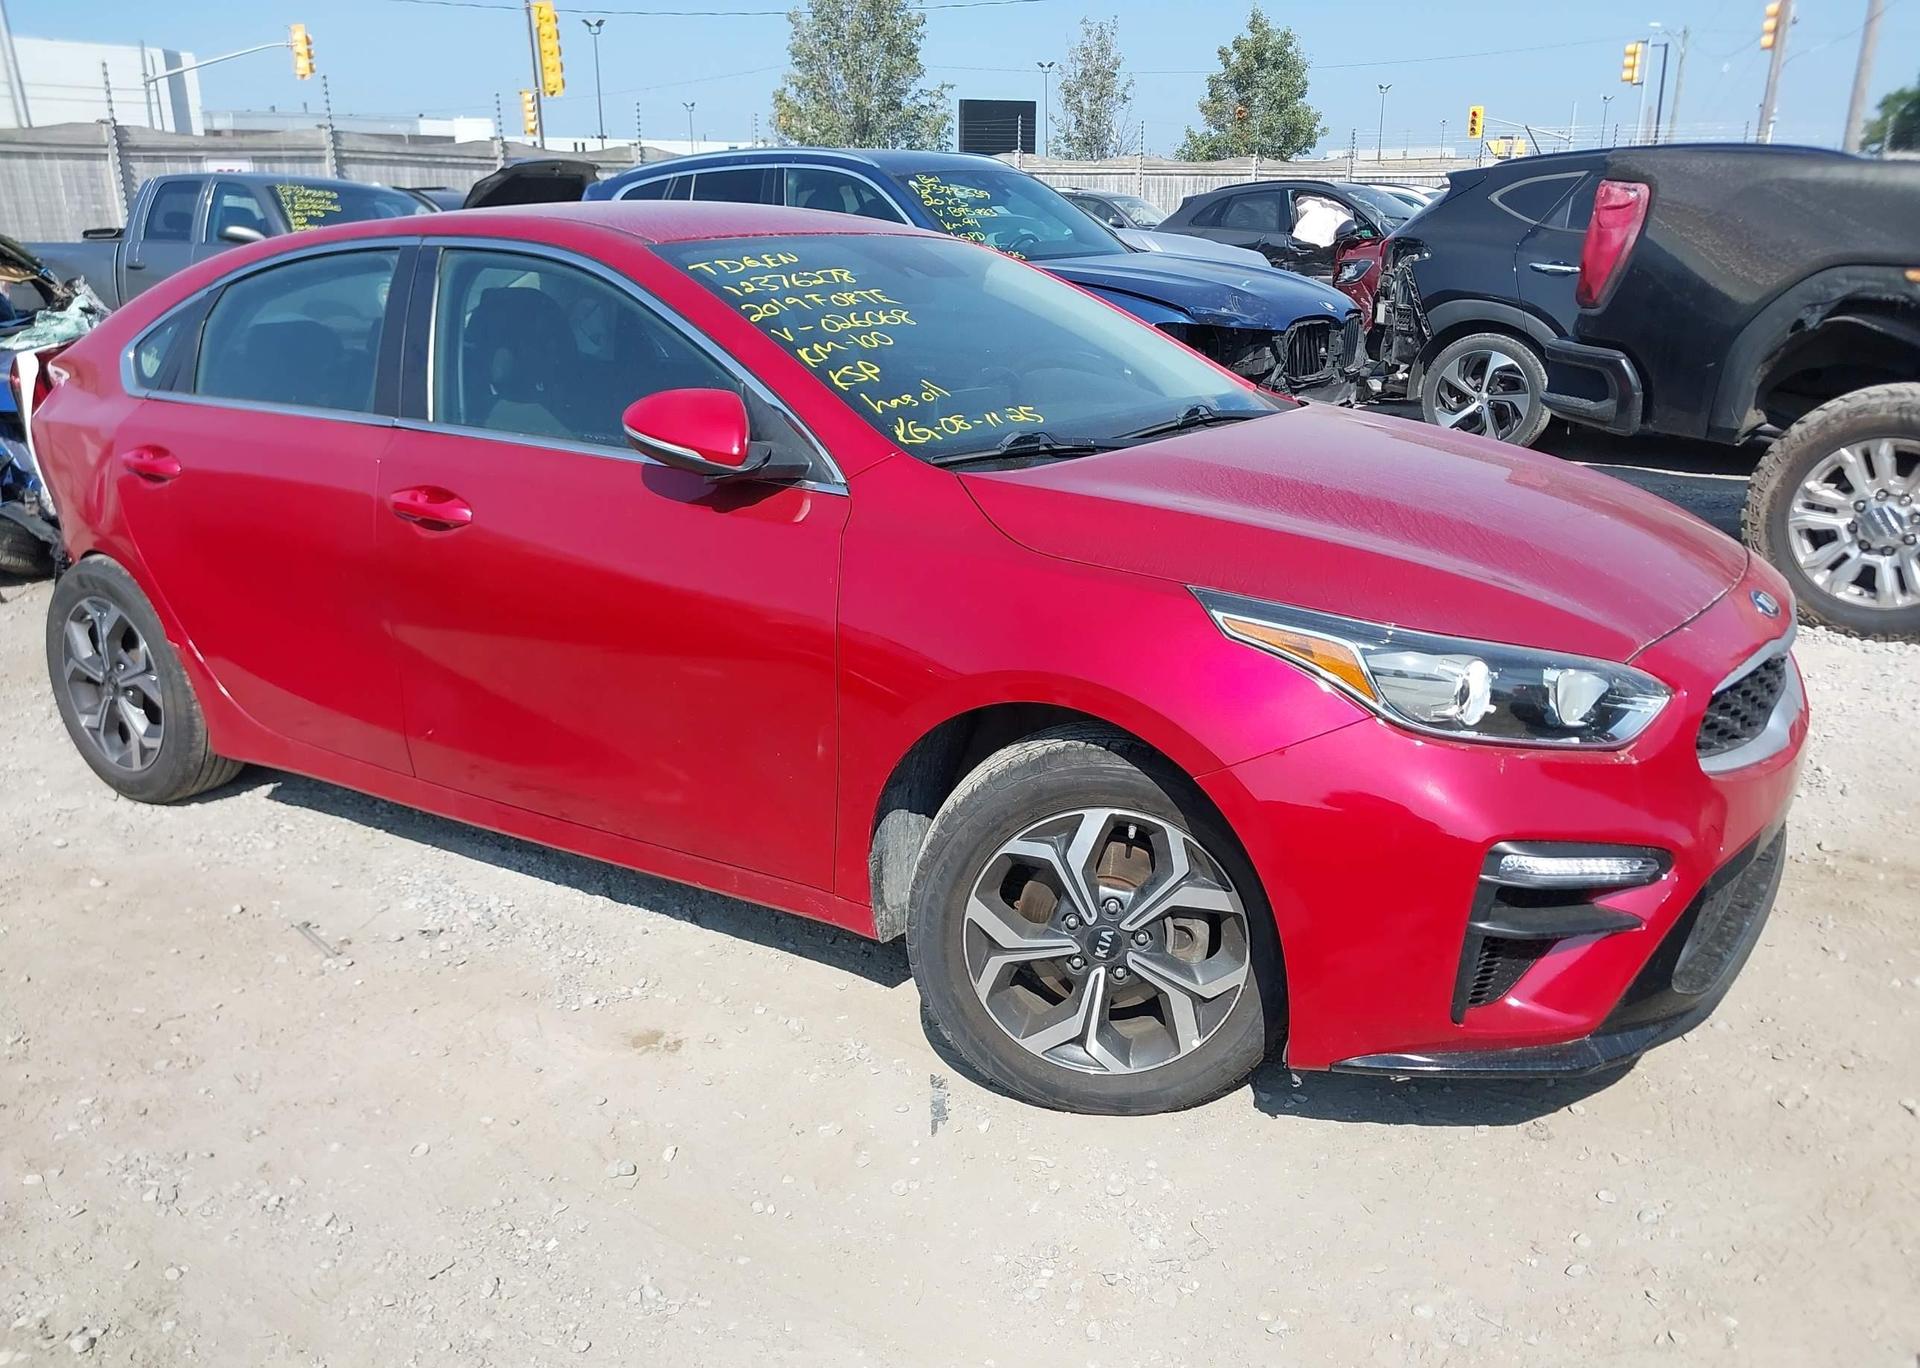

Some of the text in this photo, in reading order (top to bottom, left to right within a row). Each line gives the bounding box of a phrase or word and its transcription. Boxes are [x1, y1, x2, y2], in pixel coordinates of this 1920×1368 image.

[722, 268, 857, 297] 12376278
[740, 289, 904, 323] 2019 FORTE
[828, 360, 881, 391] KSP
[859, 393, 919, 414] has
[1094, 930, 1115, 959] KIA
